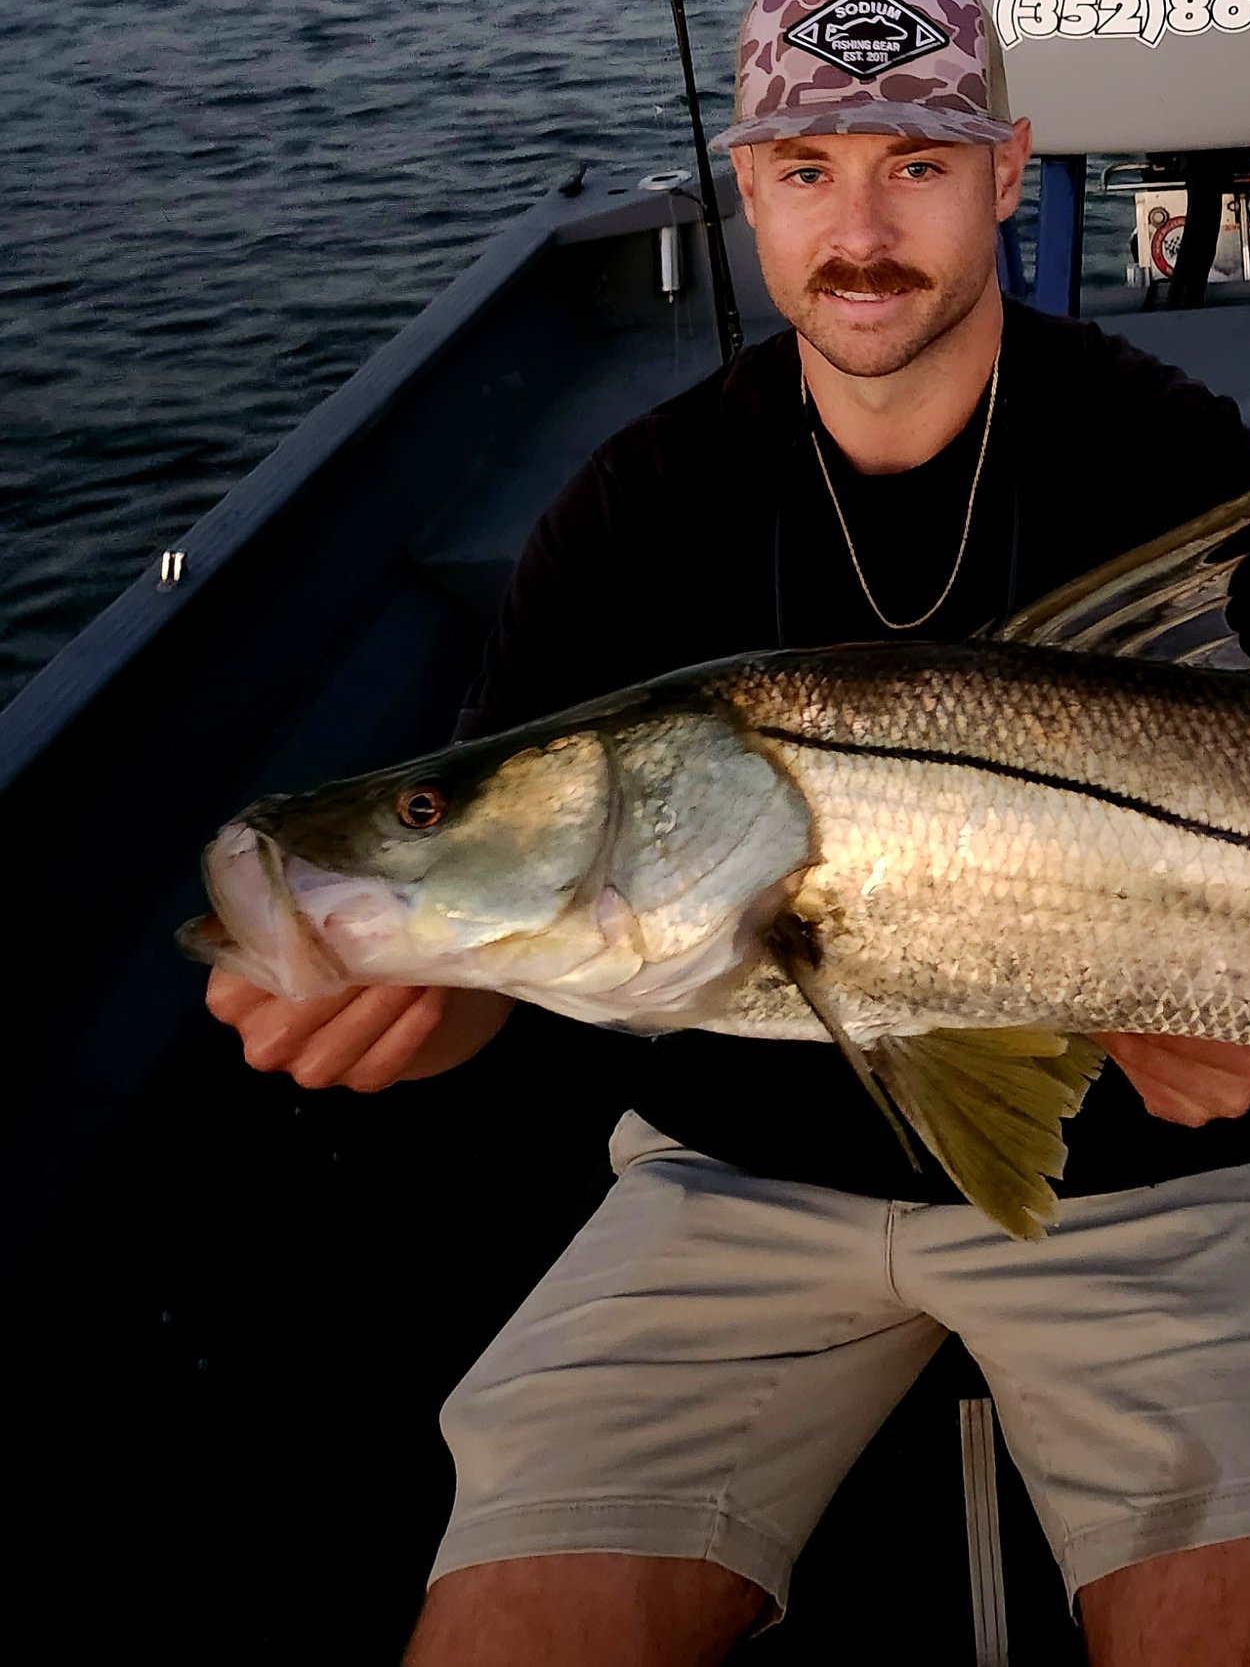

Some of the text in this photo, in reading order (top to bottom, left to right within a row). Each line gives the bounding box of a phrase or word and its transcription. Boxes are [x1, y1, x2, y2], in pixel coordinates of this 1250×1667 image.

[834, 1, 902, 21] SODIUM
[831, 39, 901, 52] FISHING GEAR
[843, 51, 865, 62] EST.
